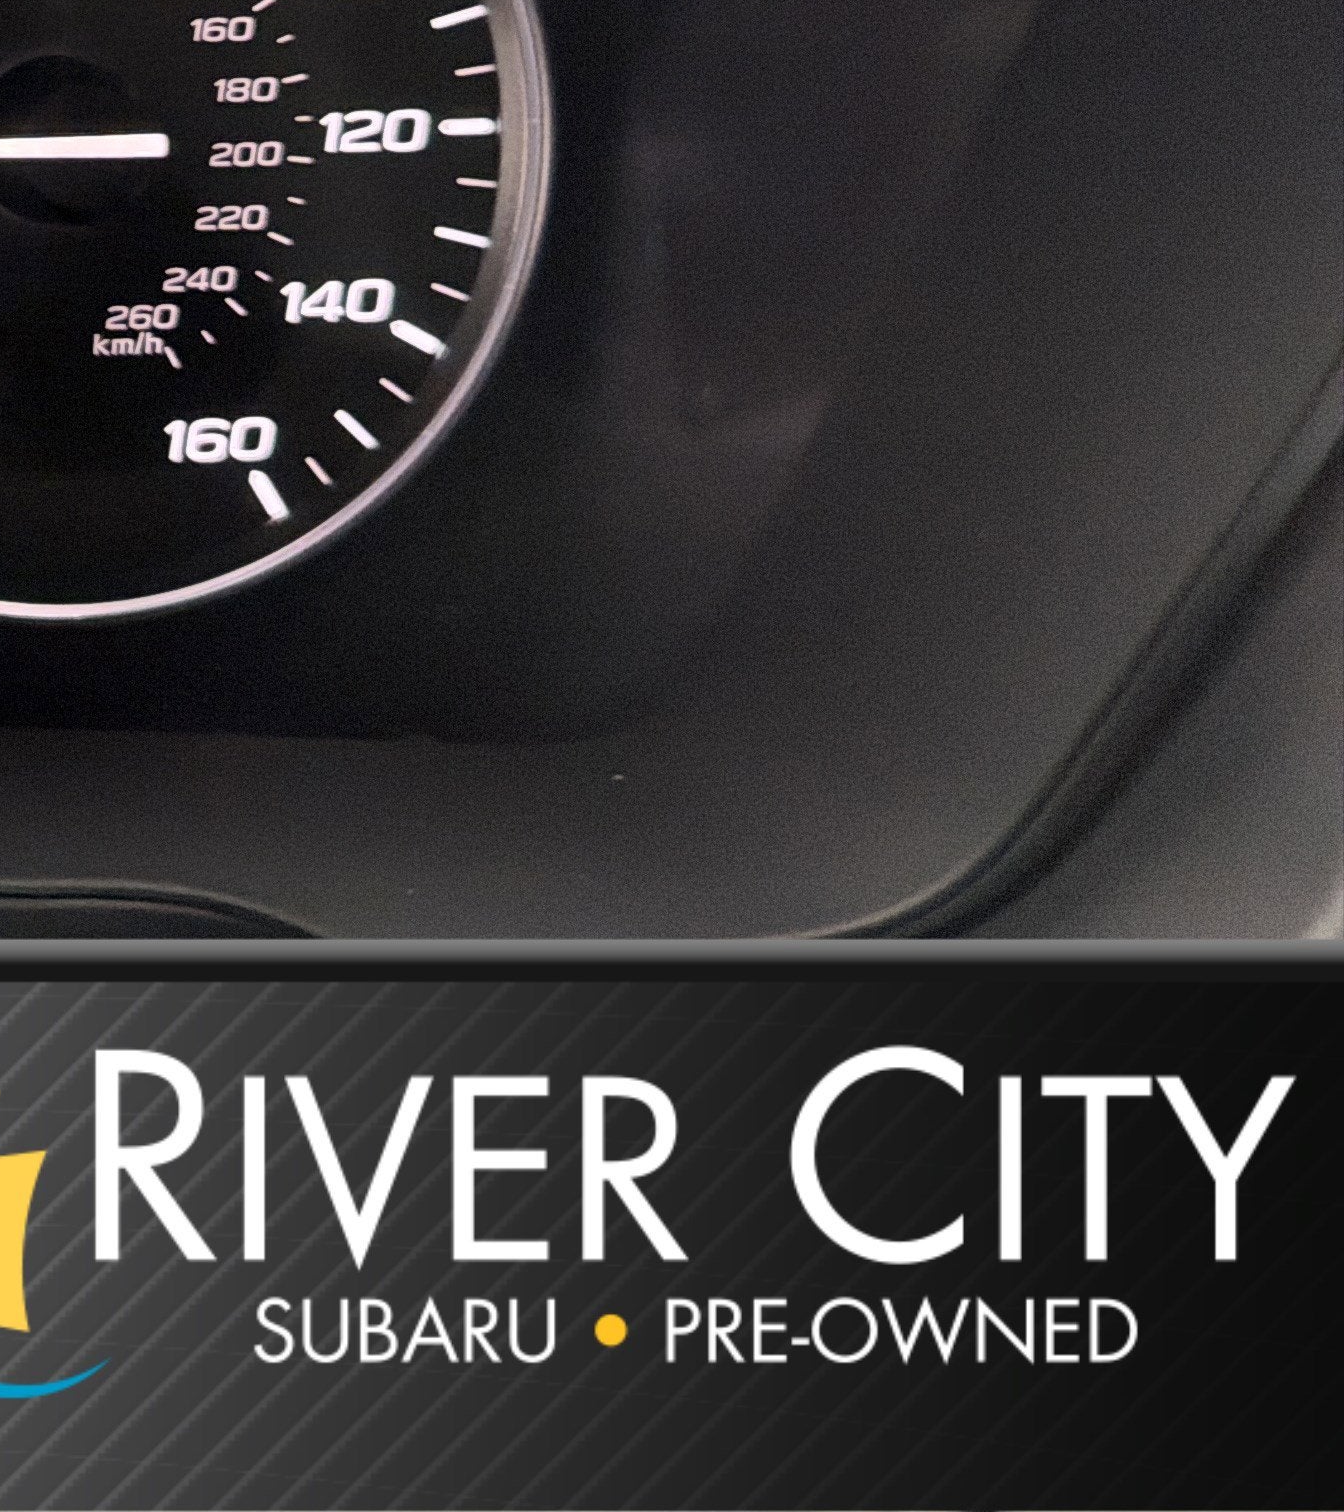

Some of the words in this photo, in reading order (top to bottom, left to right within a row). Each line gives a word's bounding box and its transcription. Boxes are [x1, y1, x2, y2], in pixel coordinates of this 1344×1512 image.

[189, 15, 257, 44] 160
[212, 75, 281, 104] 180
[317, 107, 433, 155] 120
[207, 139, 286, 169] 200
[193, 204, 269, 232] 220
[161, 264, 239, 294] 240
[278, 278, 395, 324] 140
[103, 303, 180, 332] 260
[92, 330, 166, 356] km/h
[162, 415, 279, 465] 160
